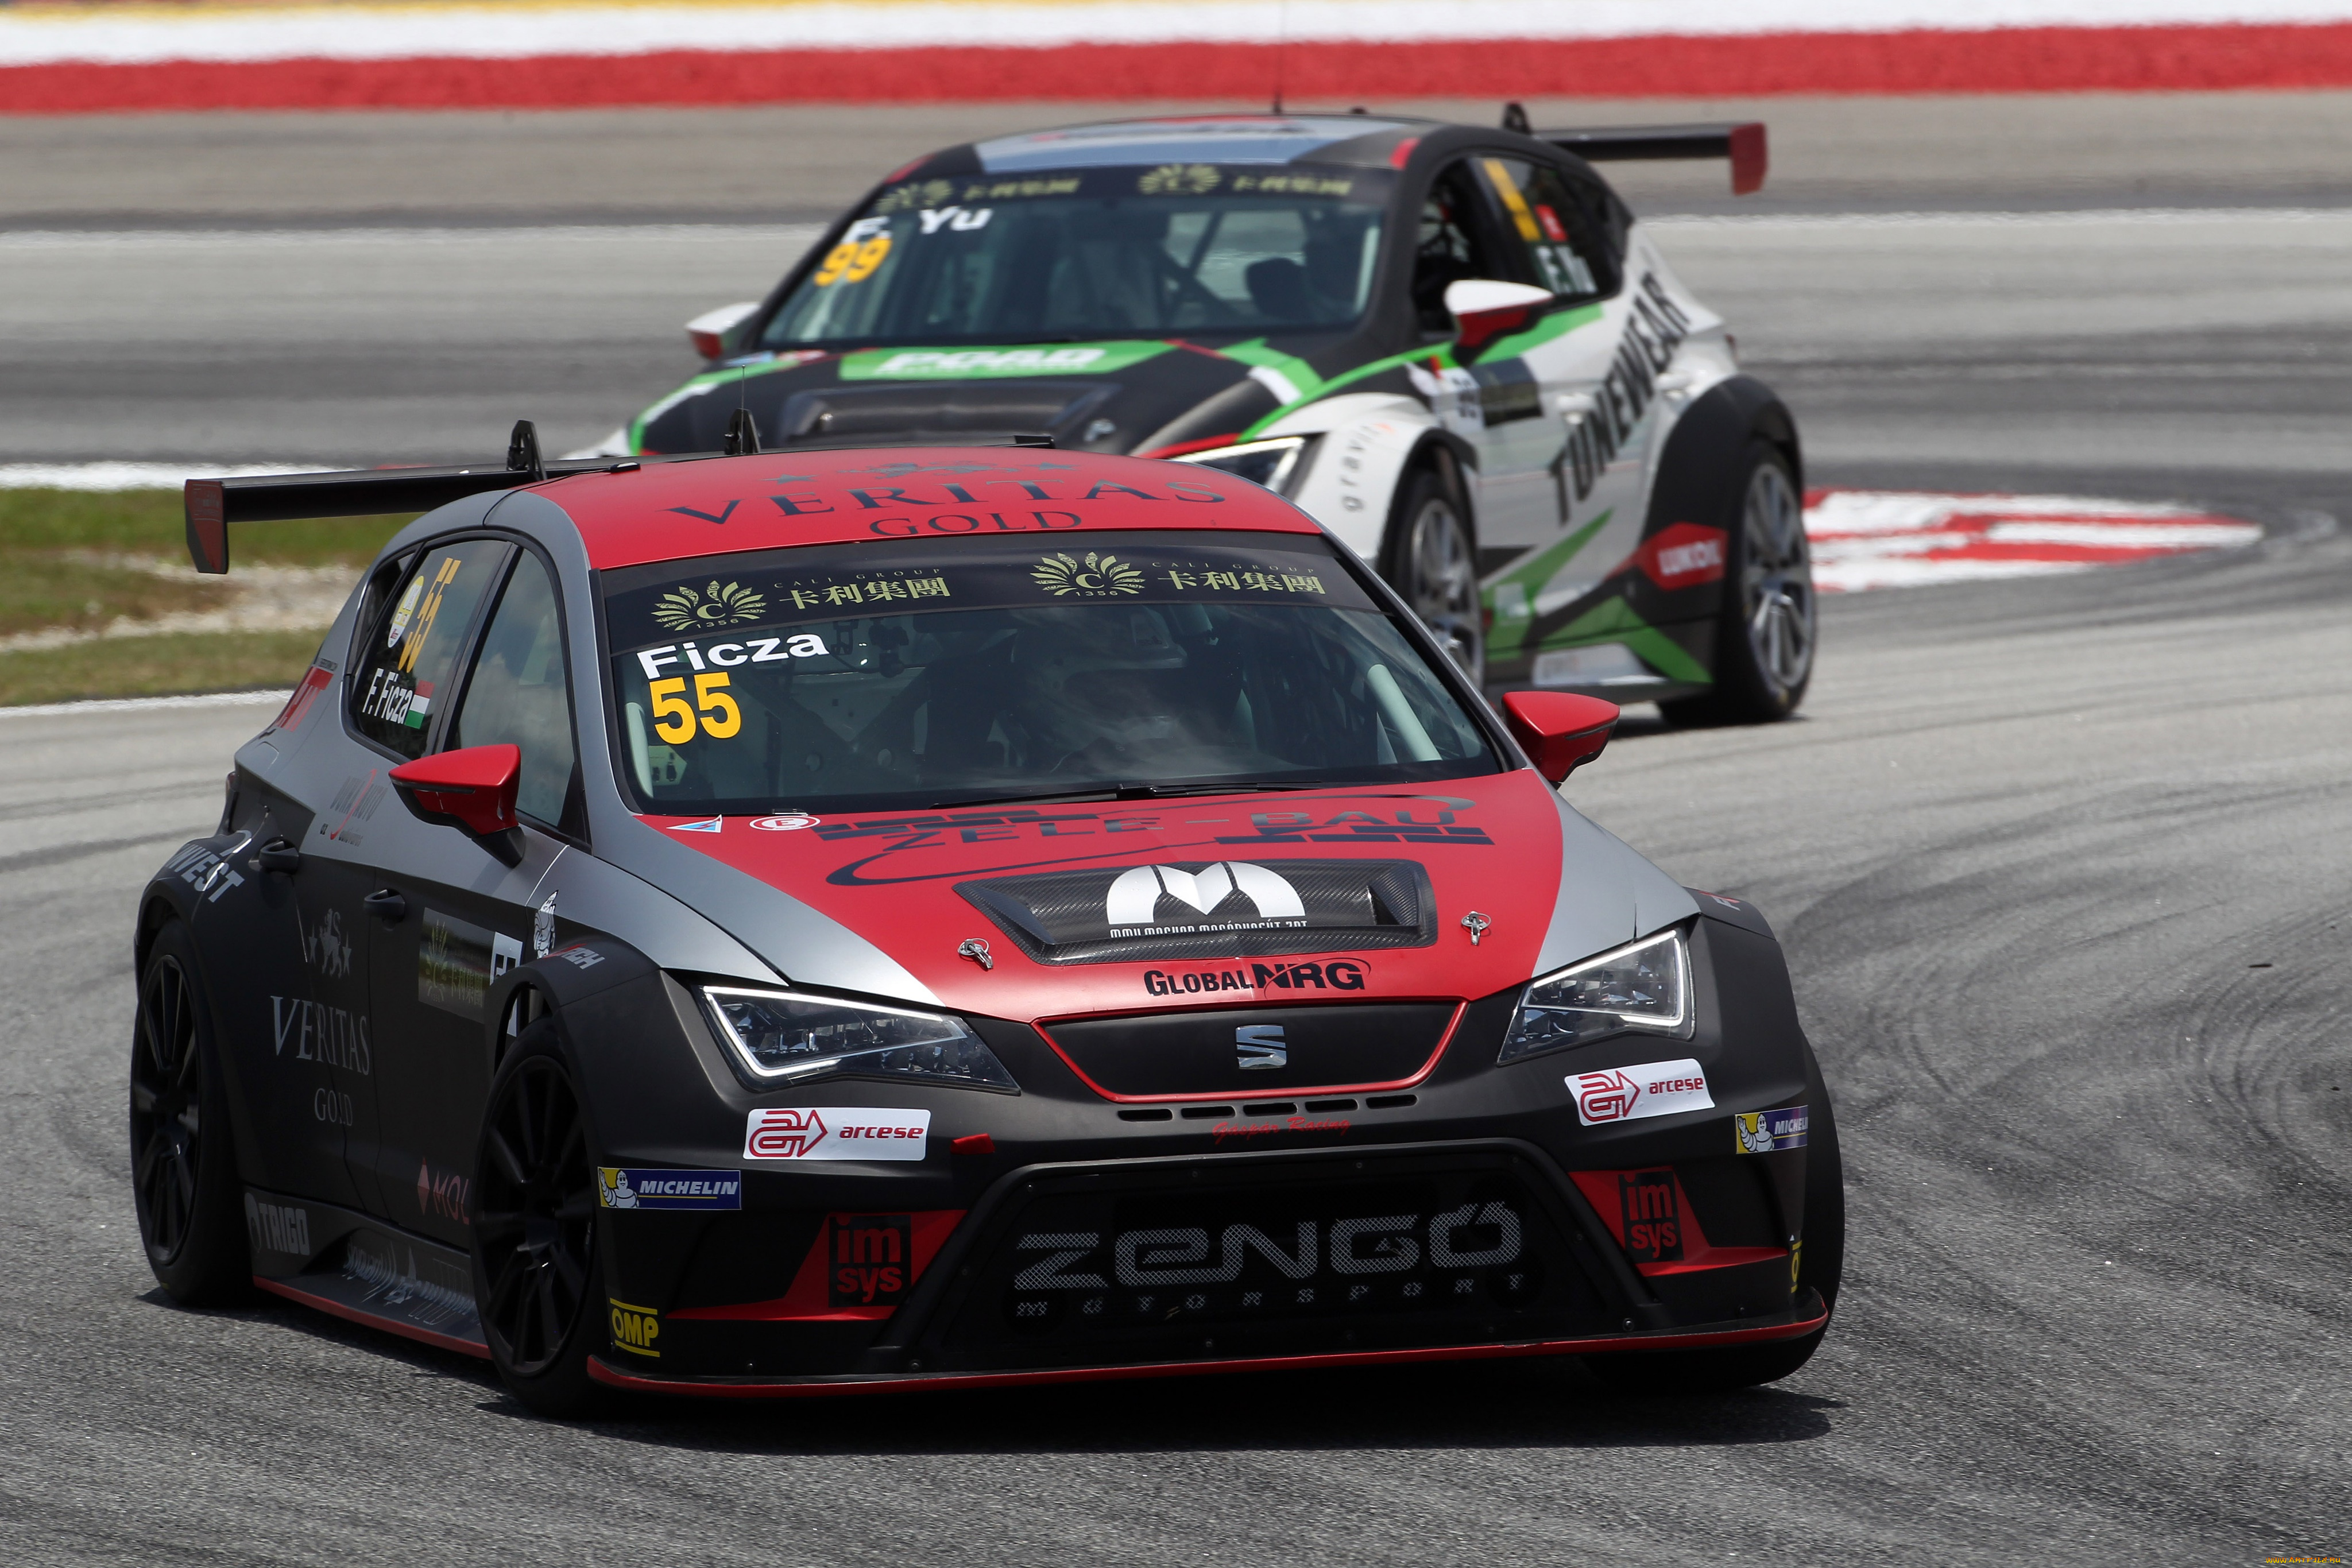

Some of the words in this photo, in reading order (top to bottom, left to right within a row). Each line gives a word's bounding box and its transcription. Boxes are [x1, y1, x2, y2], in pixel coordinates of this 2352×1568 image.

[920, 207, 993, 234] Yu
[814, 235, 893, 286] 99
[657, 478, 1226, 525] VERITAS
[869, 510, 1082, 537] GOLD
[774, 576, 831, 589] CALI
[856, 568, 940, 580] GROUP
[1157, 570, 1326, 595] 卡利集團
[1232, 563, 1314, 574] GROUP
[779, 576, 951, 610] 卡利集團
[696, 618, 739, 629] 1356
[637, 633, 829, 680] Ficza
[374, 671, 413, 725] Ficza
[649, 672, 741, 745] 55
[776, 819, 796, 827] E
[270, 995, 370, 1075] VERITAS
[1649, 1076, 1704, 1095] arcese
[314, 1087, 353, 1126] GOLD
[839, 1124, 924, 1140] arcese
[1287, 1116, 1351, 1136] Racing
[433, 1170, 470, 1225] MOL
[640, 1180, 739, 1196] MICHELIN
[1627, 1173, 1673, 1221] im
[258, 1202, 311, 1256] TRIGO
[837, 1216, 901, 1263] im
[1631, 1222, 1677, 1259] sys
[837, 1266, 902, 1303] sys
[612, 1311, 659, 1348] OMP
